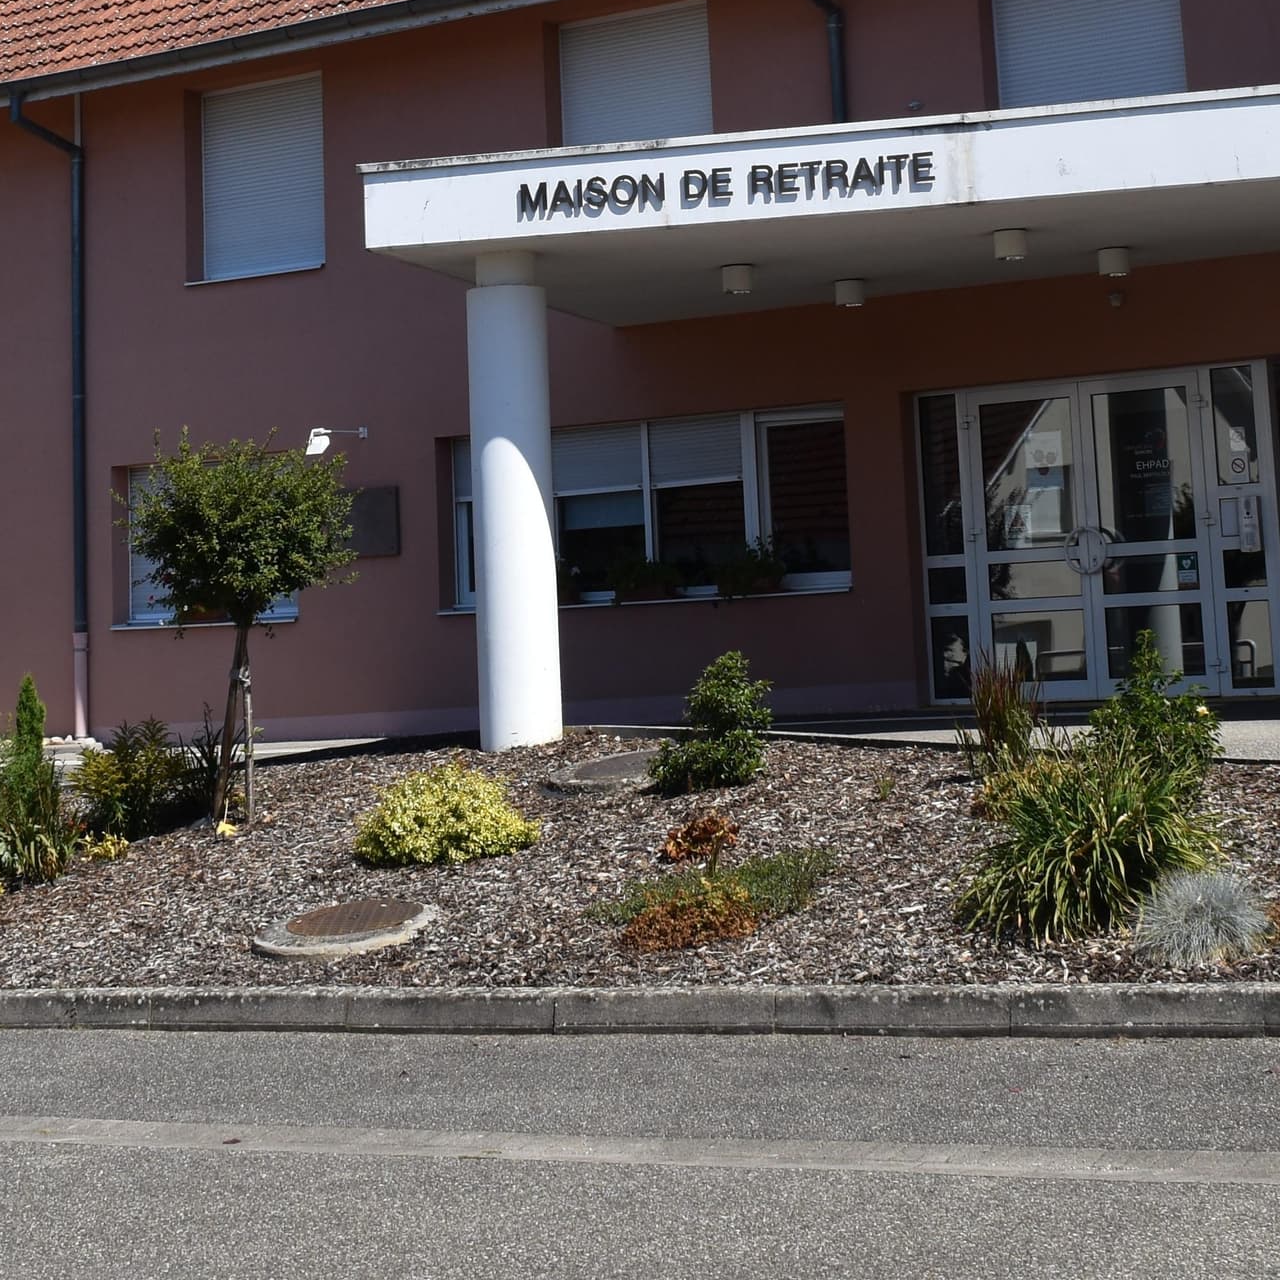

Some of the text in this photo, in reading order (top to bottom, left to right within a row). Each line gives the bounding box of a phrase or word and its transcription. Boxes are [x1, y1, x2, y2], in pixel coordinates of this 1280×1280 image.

[519, 151, 936, 213] MAISON DE RETRAITE
[1136, 458, 1170, 470] EHPAD
